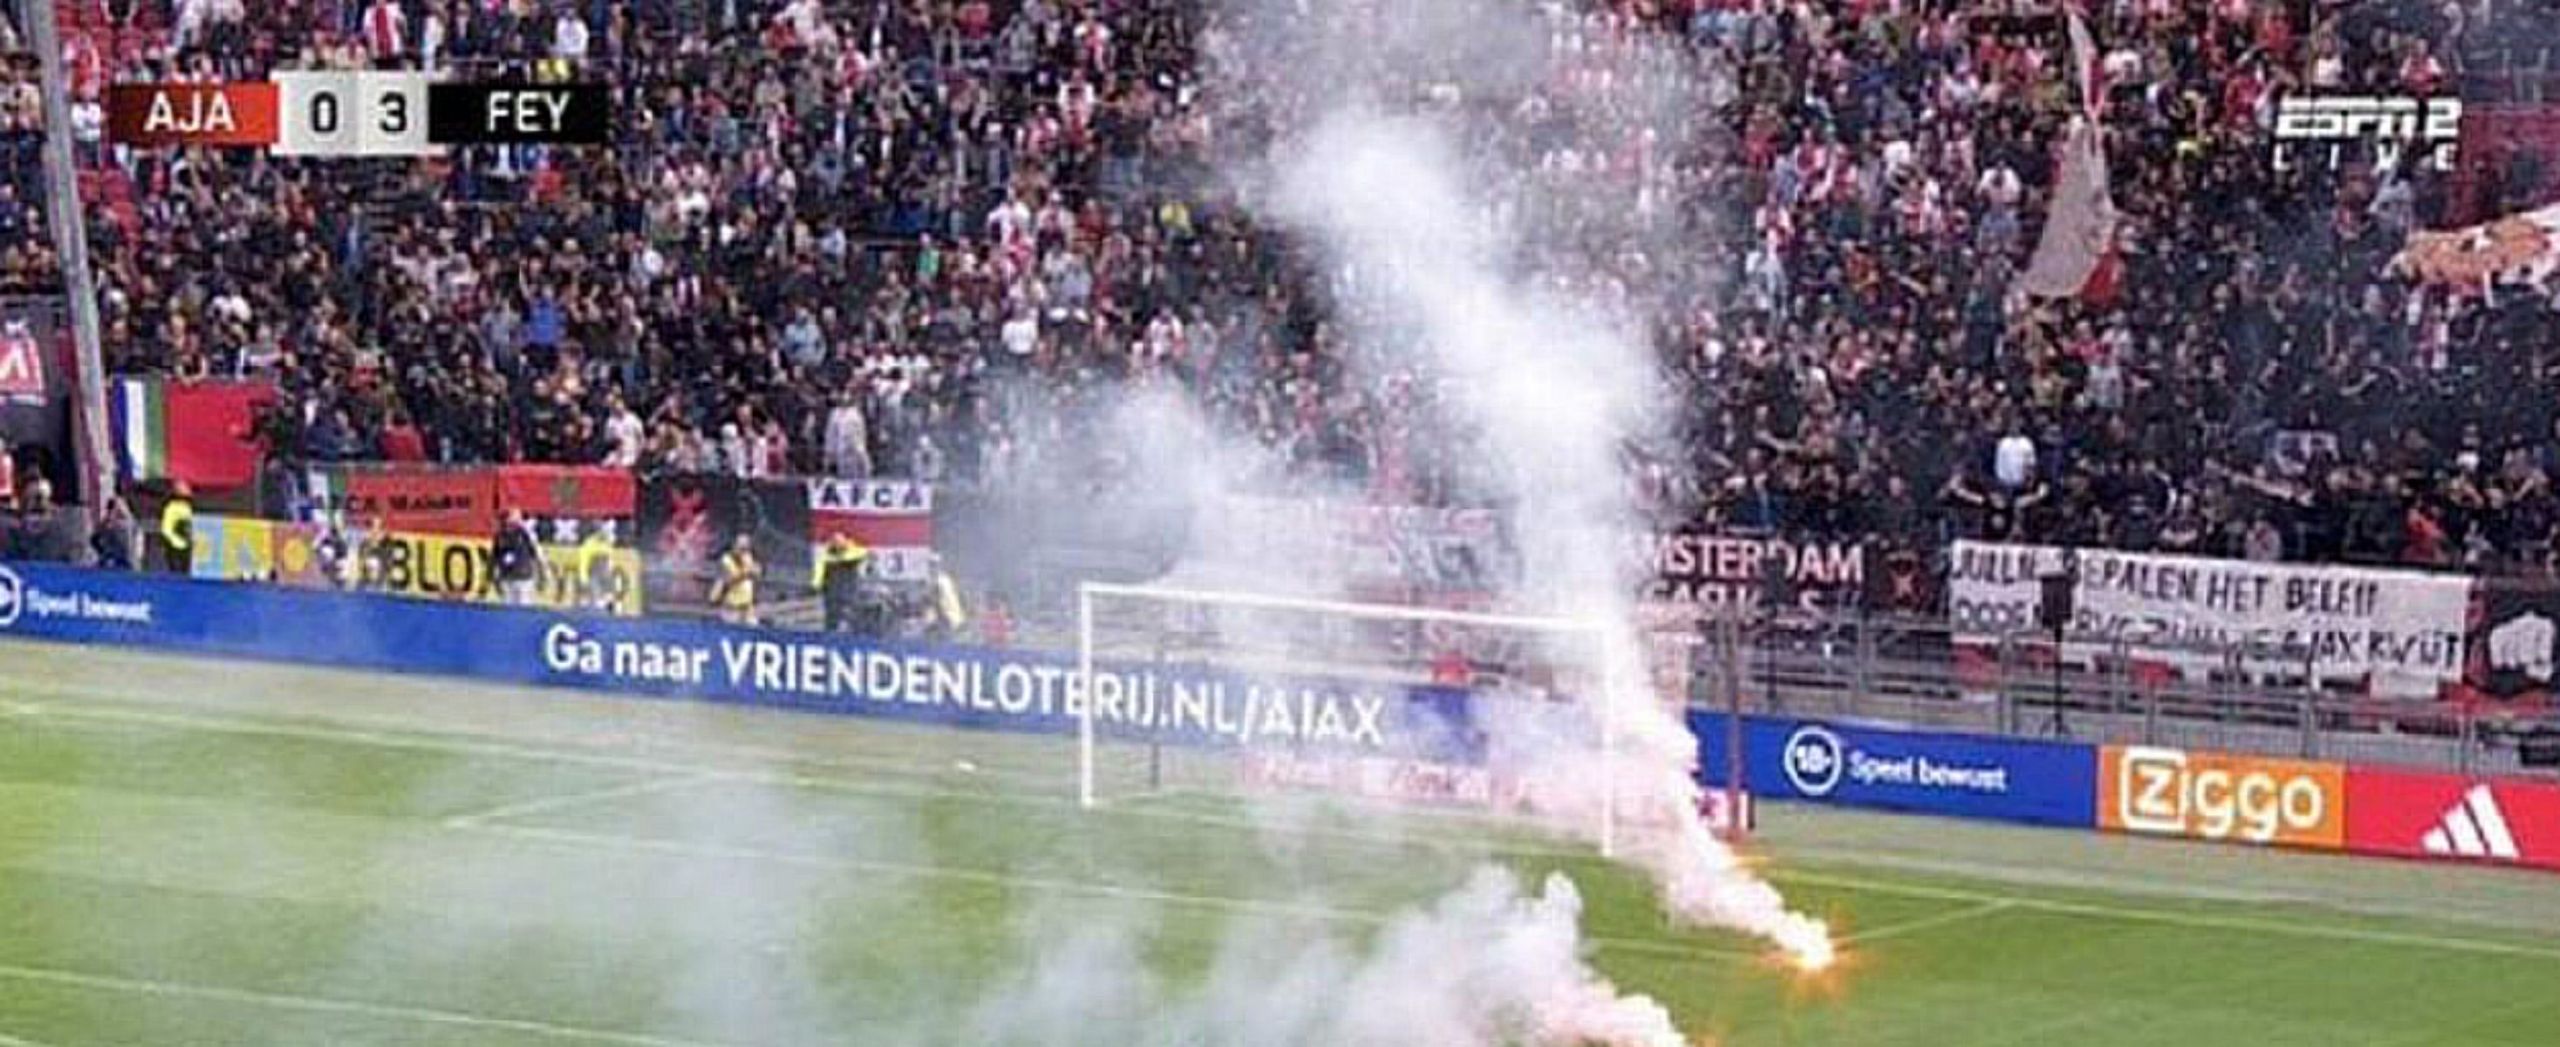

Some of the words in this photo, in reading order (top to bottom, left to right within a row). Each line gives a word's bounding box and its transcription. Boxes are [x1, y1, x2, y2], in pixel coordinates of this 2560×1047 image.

[1630, 533, 1863, 583] MSTERDAM
[2205, 567, 2268, 612] HET
[546, 623, 600, 674] Ga
[614, 640, 707, 683] naar
